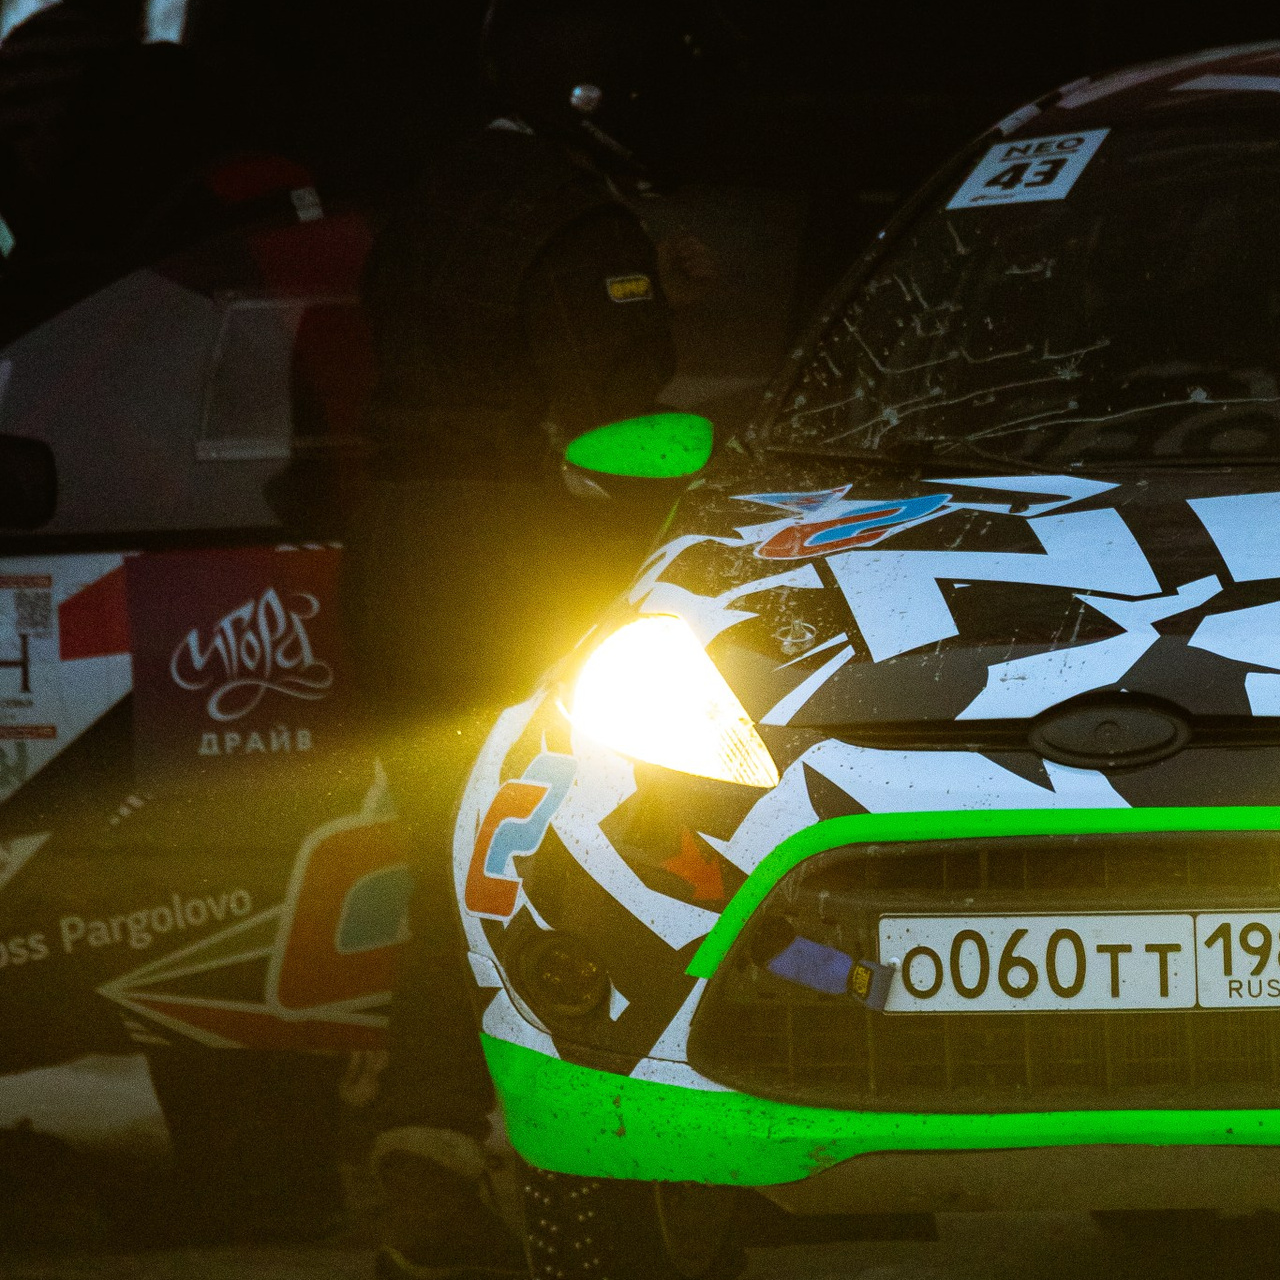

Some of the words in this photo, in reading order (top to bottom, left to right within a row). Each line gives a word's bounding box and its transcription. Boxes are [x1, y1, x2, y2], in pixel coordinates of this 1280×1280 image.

[1003, 137, 1085, 158] NEO
[983, 158, 1069, 190] 43
[198, 724, 313, 756] ДРАЙВ
[59, 889, 253, 954] Pargolovo
